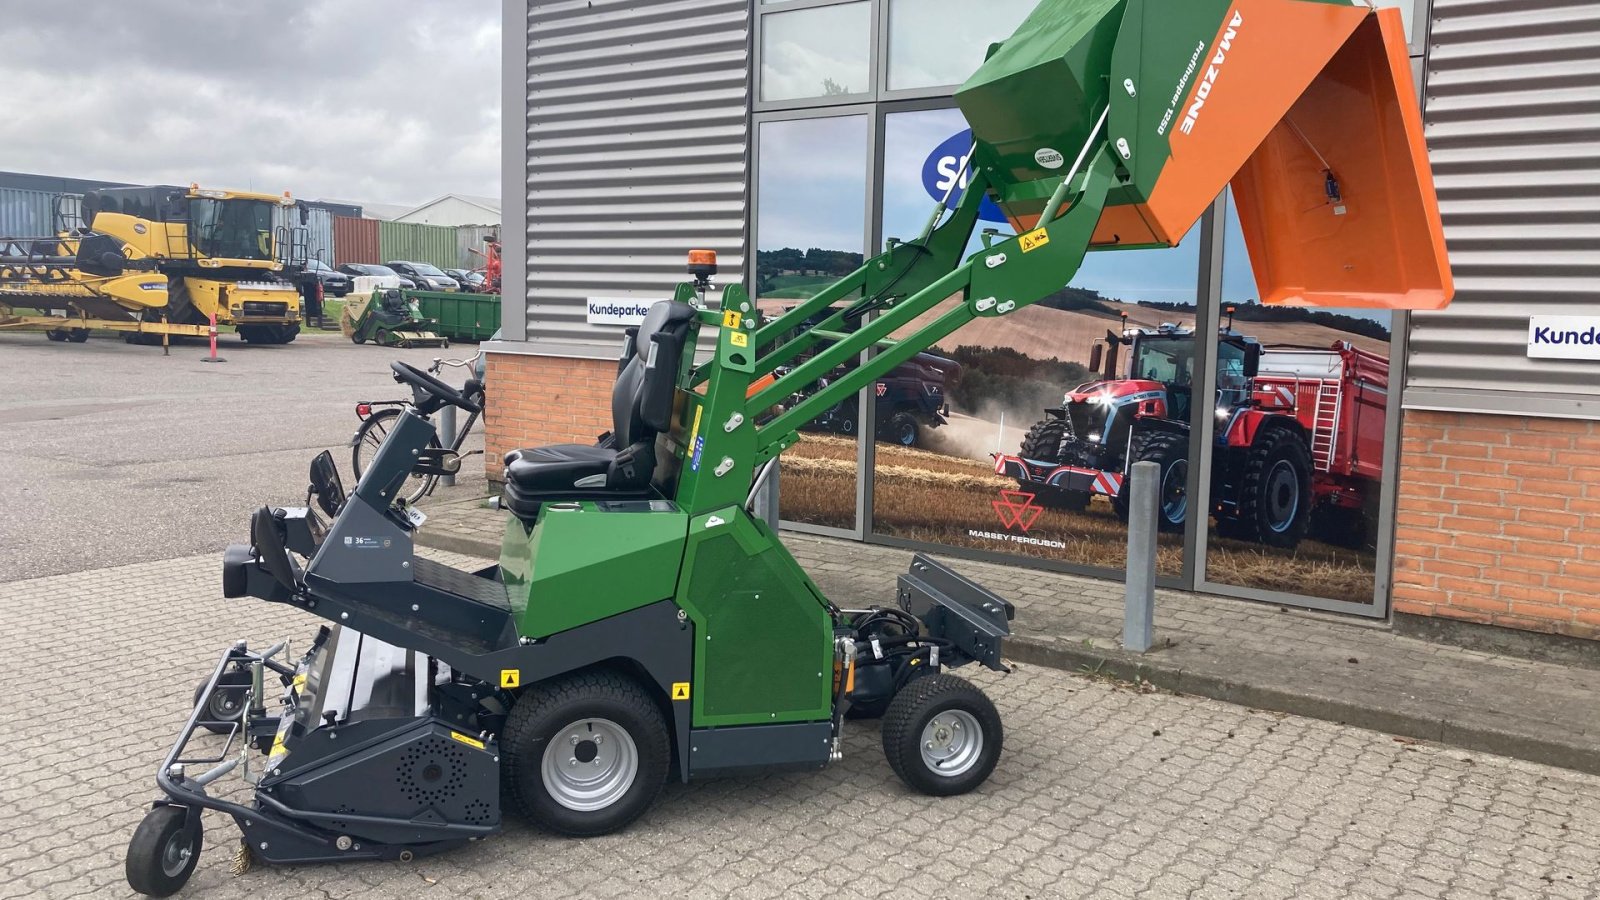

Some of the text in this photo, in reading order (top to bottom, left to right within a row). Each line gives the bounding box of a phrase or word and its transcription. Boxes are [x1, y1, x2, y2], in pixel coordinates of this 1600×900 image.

[1156, 40, 1206, 136] Profihopper 1250
[1179, 9, 1243, 136] AMAZONE
[588, 303, 650, 319] Kundeparke
[968, 529, 1066, 549] MASSEY FERGUSON
